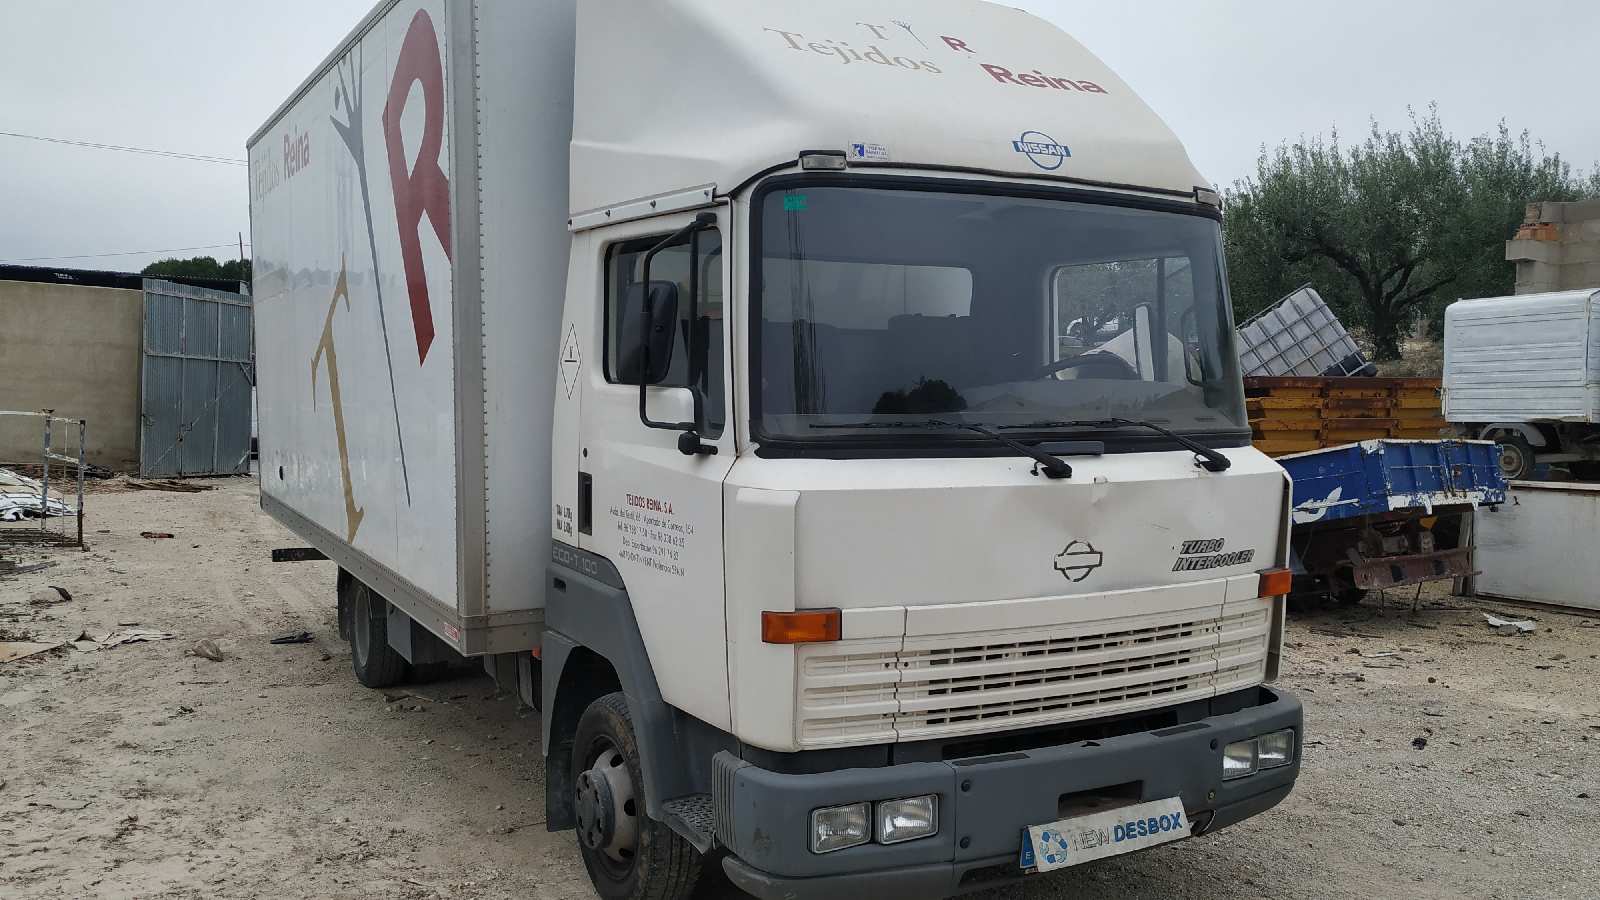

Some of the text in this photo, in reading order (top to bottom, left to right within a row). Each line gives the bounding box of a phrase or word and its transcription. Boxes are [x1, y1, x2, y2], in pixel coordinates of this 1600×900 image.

[940, 35, 976, 54] R
[763, 27, 1109, 94] Tejidos Reina
[282, 124, 310, 182] Reina
[1016, 141, 1067, 157] NISSAN
[626, 494, 646, 509] TEJIDOS
[1180, 538, 1225, 554] TURBO
[1172, 549, 1255, 571] INTERCOOLER
[1072, 812, 1183, 851] NEW DESBOX
